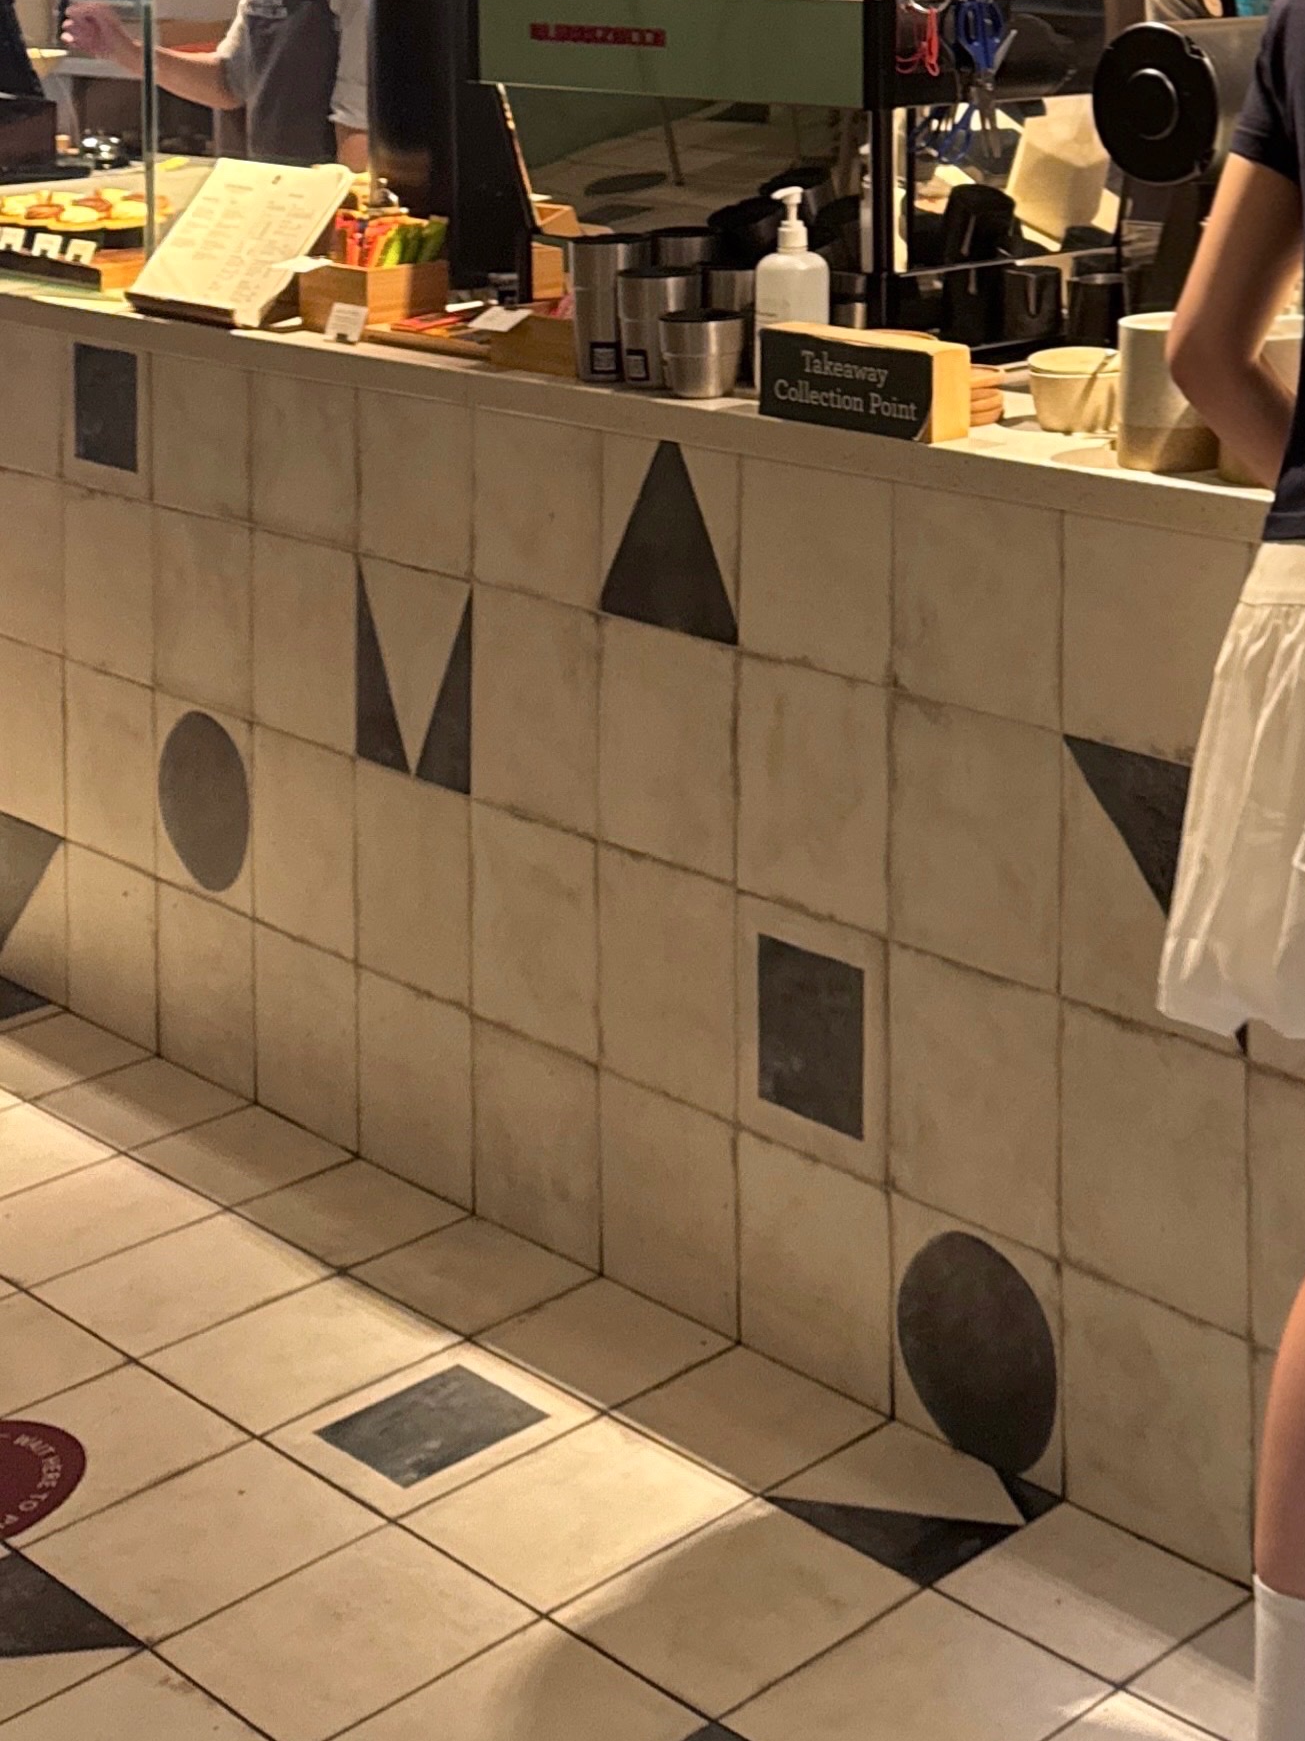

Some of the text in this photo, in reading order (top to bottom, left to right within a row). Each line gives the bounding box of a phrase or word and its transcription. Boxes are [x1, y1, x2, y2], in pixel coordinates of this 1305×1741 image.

[801, 349, 889, 388] Takeaway
[773, 378, 918, 421] Collection Point
[18, 1492, 50, 1512] TO
